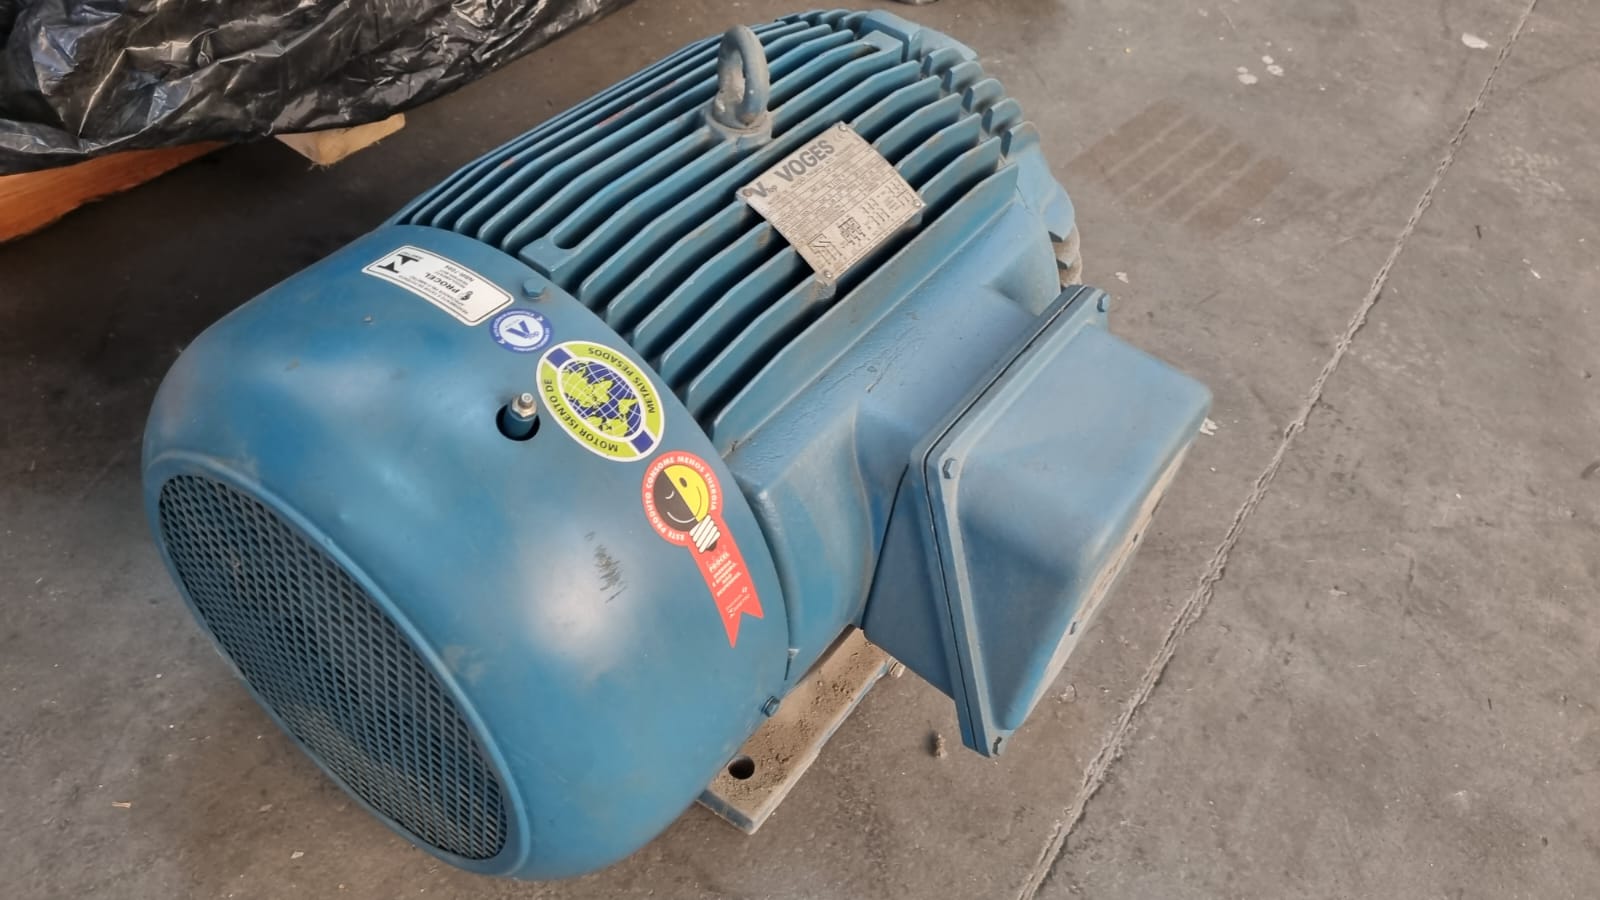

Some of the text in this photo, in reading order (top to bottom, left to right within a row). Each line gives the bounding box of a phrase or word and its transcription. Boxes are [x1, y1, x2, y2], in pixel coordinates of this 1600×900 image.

[773, 138, 835, 182] VOGES
[424, 272, 461, 294] PROCEL
[587, 347, 656, 414] METAIS PESADOS
[543, 378, 619, 453] MOTOR ISENTO DE
[644, 455, 718, 541] ESTE PRODUTO CONSOME MENOS ENERGIA
